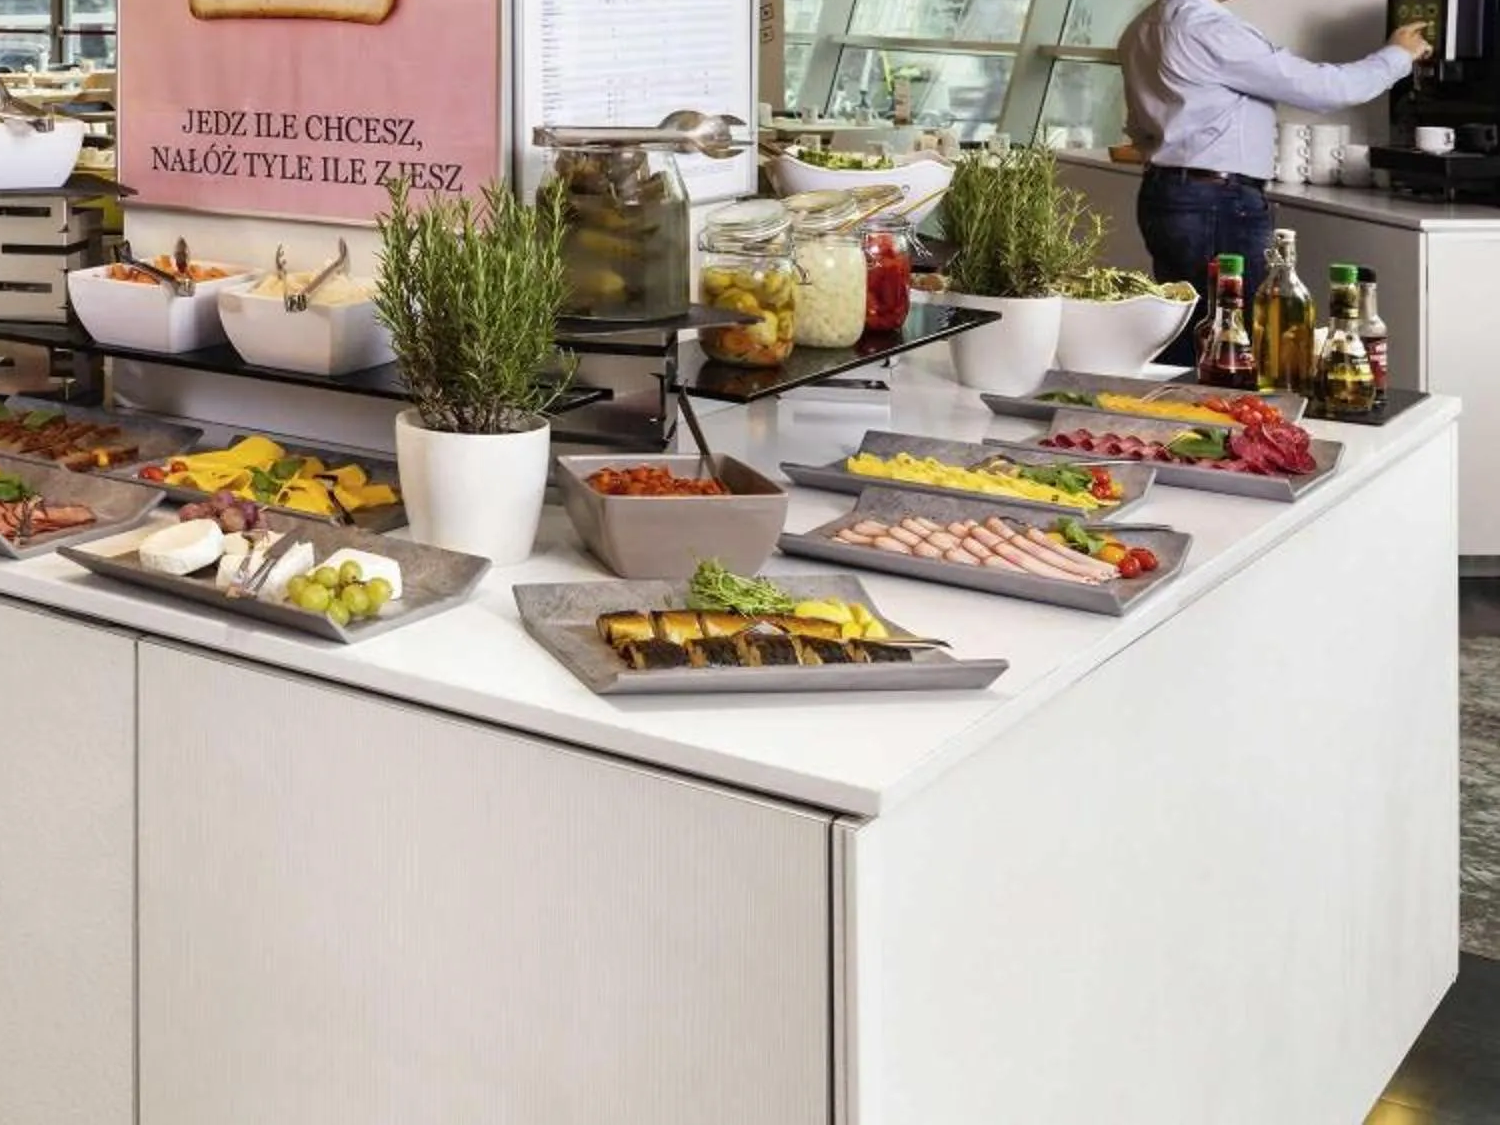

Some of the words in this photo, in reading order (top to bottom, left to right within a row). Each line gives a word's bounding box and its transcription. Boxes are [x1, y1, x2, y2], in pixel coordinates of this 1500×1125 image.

[182, 109, 247, 137] JEDZ
[254, 112, 298, 140] ILE
[305, 114, 423, 151] CHCESZ,
[151, 143, 237, 176] NAŁÓŻ
[243, 152, 313, 182] TYLE
[321, 157, 367, 186] ILE
